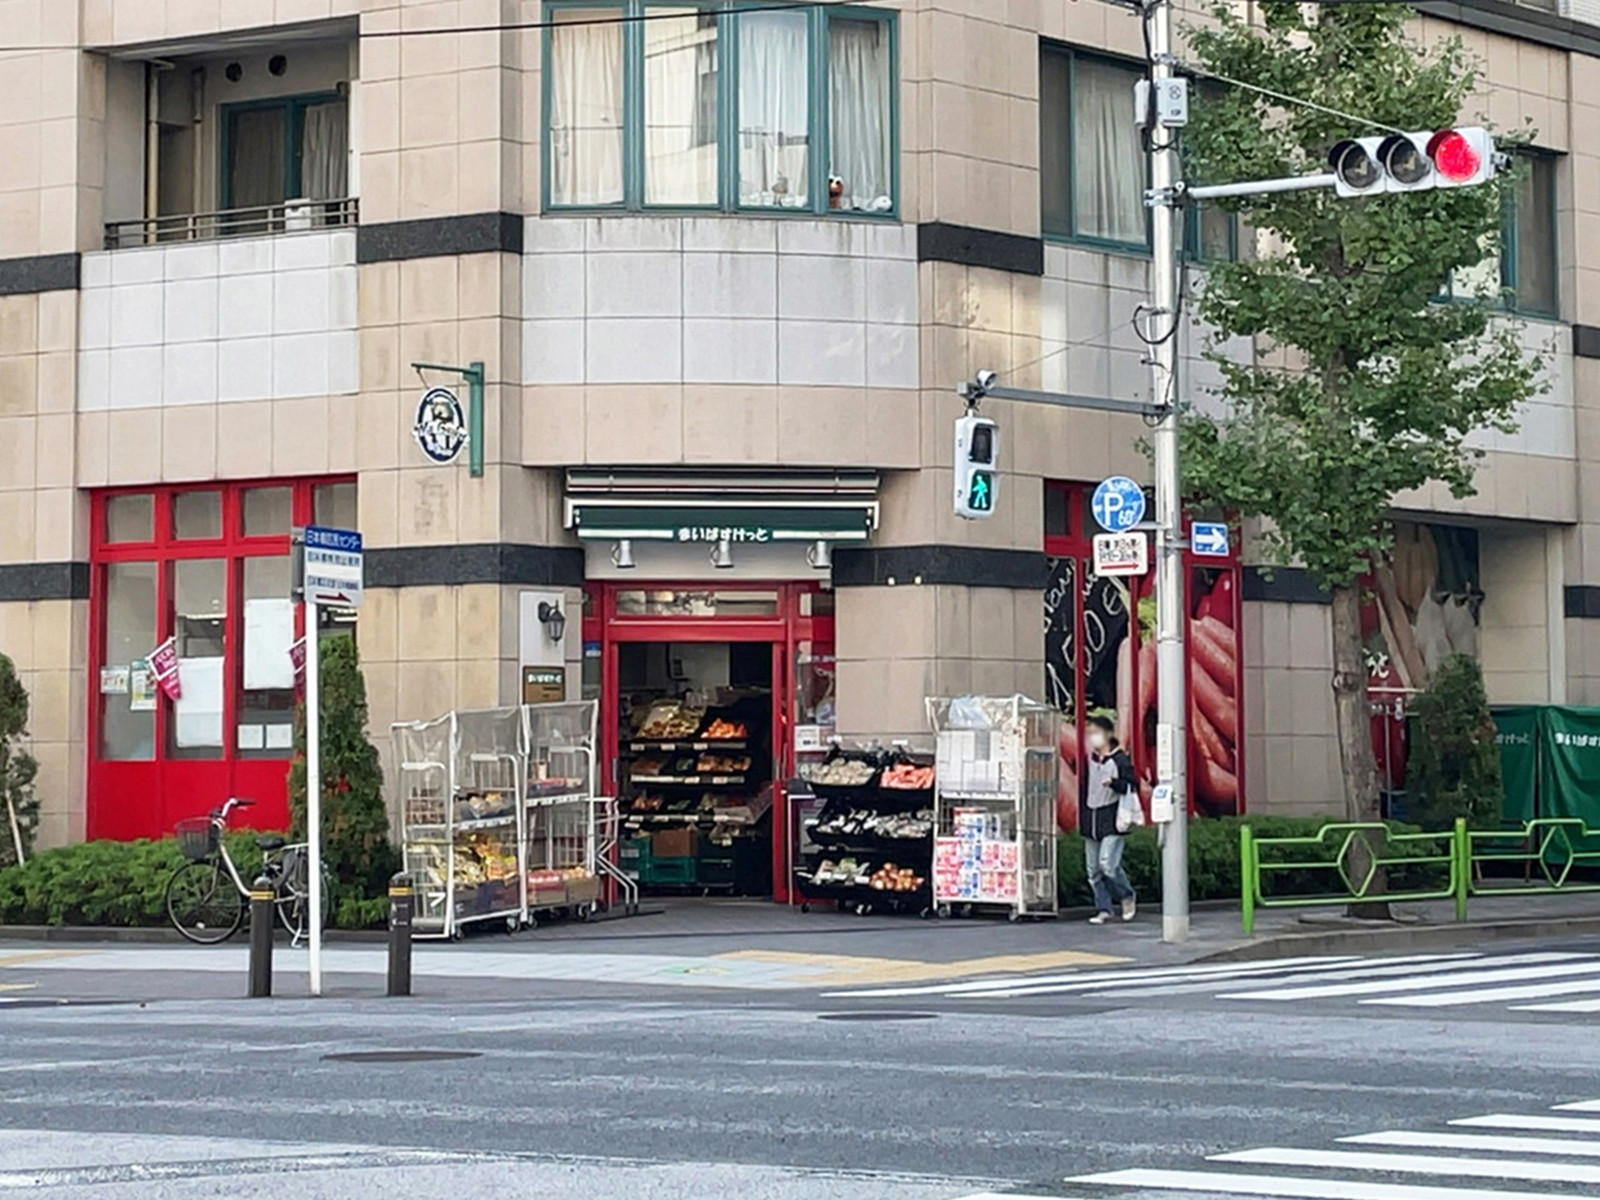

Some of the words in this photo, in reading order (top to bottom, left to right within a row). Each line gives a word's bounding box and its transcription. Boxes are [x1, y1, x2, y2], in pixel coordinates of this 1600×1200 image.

[1104, 492, 1124, 526] P
[679, 527, 768, 542] まいばすけっと
